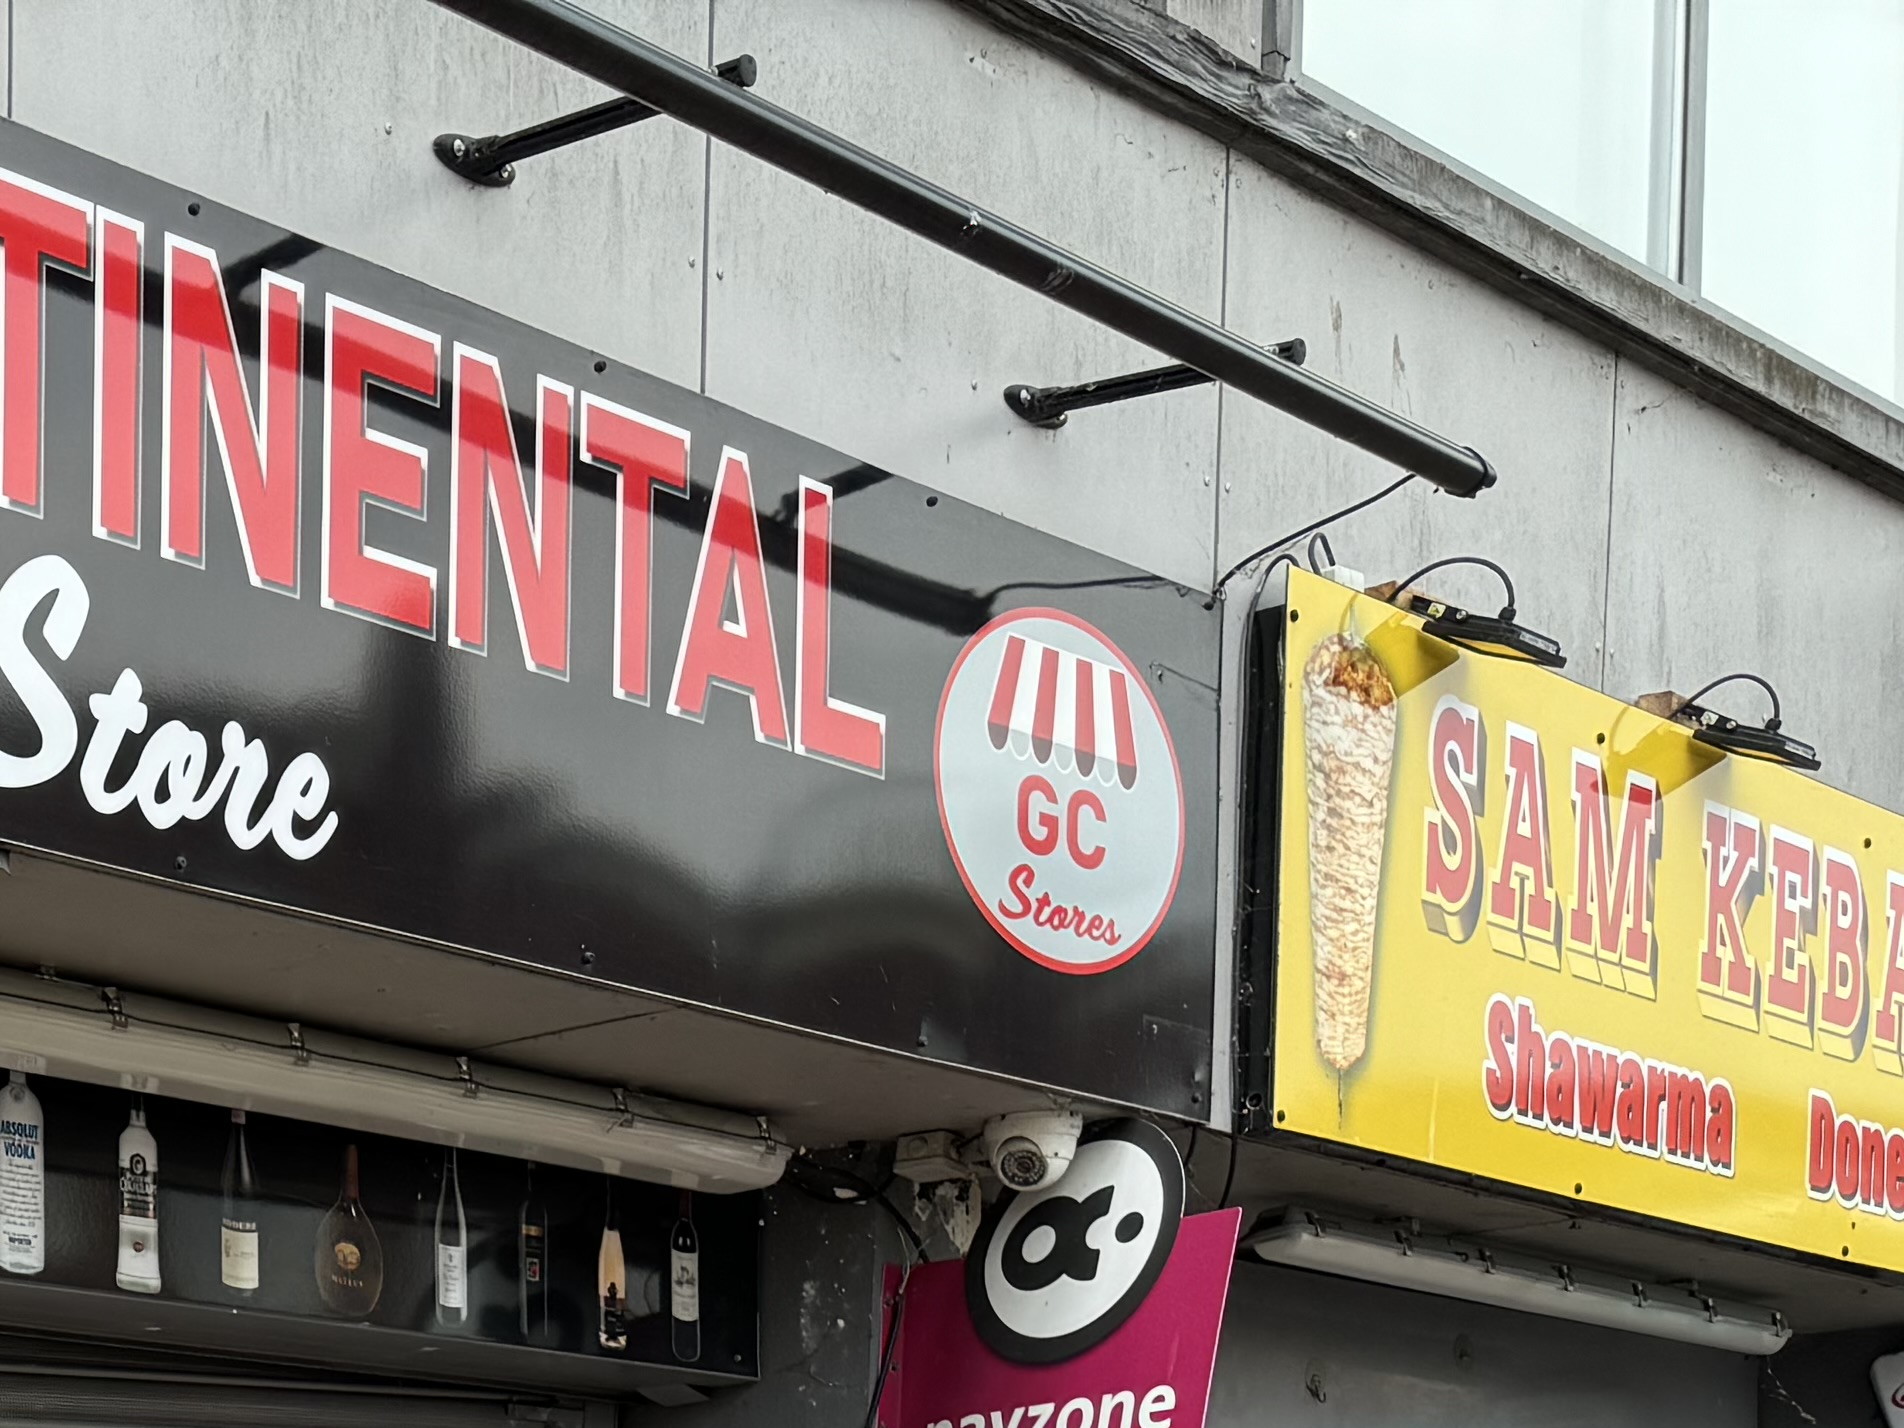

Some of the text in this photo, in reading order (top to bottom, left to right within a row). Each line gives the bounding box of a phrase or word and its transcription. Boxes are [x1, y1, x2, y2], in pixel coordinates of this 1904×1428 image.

[1015, 773, 1109, 870] GC
[1421, 693, 1663, 1002] SAM
[998, 862, 1123, 948] Stores
[0, 1119, 39, 1140] ABSOLUT
[1484, 994, 1737, 1178] Shawarma
[3, 1141, 36, 1160] VODKA
